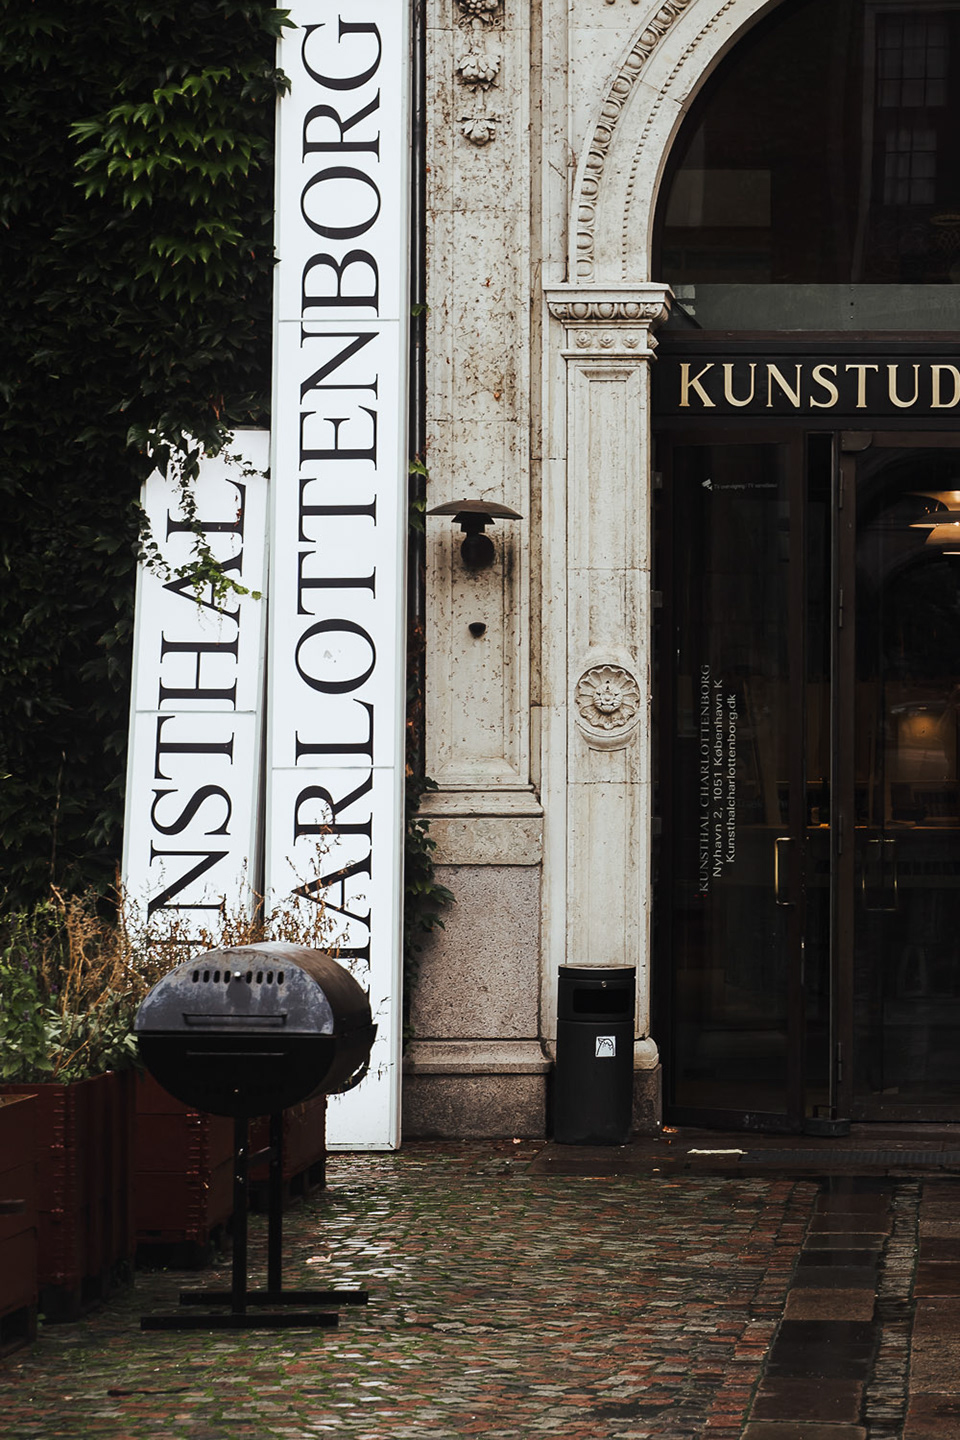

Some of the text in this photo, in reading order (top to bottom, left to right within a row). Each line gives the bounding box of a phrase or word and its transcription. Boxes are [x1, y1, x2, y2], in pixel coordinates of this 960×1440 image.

[699, 664, 710, 892] KUNSTHAL CHARLOTTENBORG
[712, 679, 724, 877] Nyhavn 2, 1051 København K
[725, 694, 738, 863] Kunsthalcharlottenborg.dk
